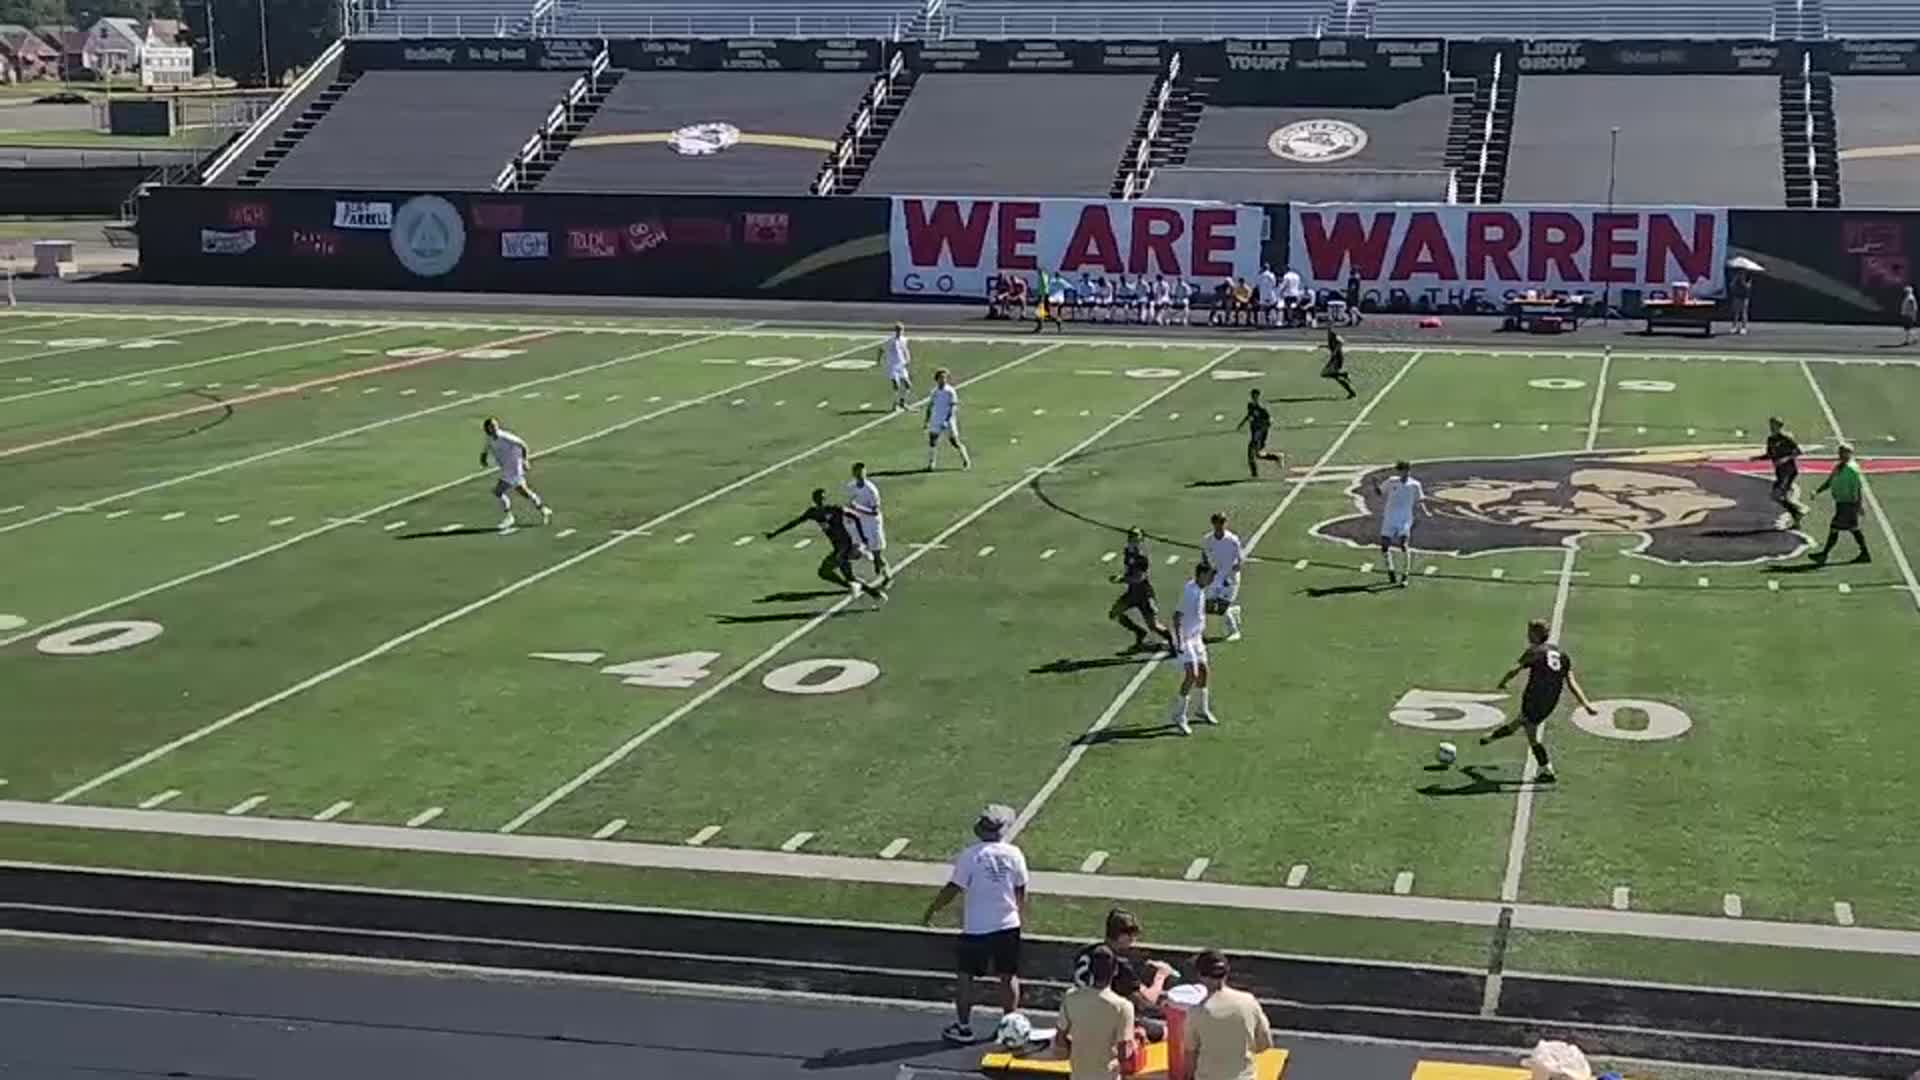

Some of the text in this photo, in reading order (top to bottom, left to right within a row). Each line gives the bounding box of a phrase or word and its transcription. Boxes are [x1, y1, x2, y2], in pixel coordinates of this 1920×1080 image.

[1518, 56, 1586, 71] GROUP
[903, 200, 1237, 277] WE ARE
[1300, 211, 1715, 283] WARREN
[1547, 650, 1561, 671] 6
